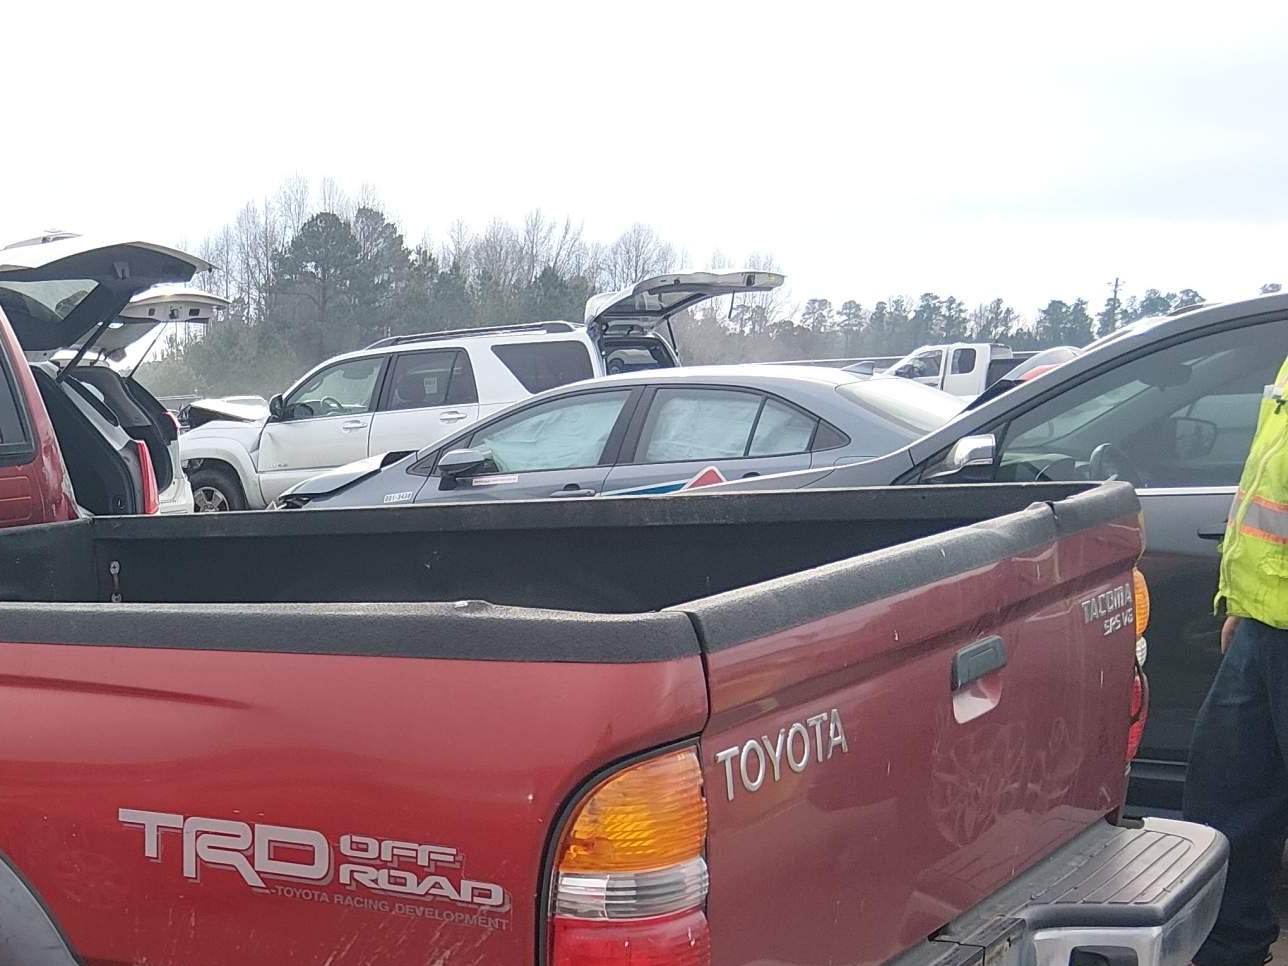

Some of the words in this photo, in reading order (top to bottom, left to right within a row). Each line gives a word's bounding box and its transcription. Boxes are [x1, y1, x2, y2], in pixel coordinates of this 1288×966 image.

[1081, 583, 1132, 624] TACOMA
[1122, 607, 1133, 626] V6
[714, 708, 849, 801] TOYOTA
[118, 807, 332, 891] TRD
[339, 833, 459, 868] OFF
[339, 863, 510, 910] ROAD
[334, 894, 390, 913] RACING
[396, 903, 509, 930] DEVELOPMENT
